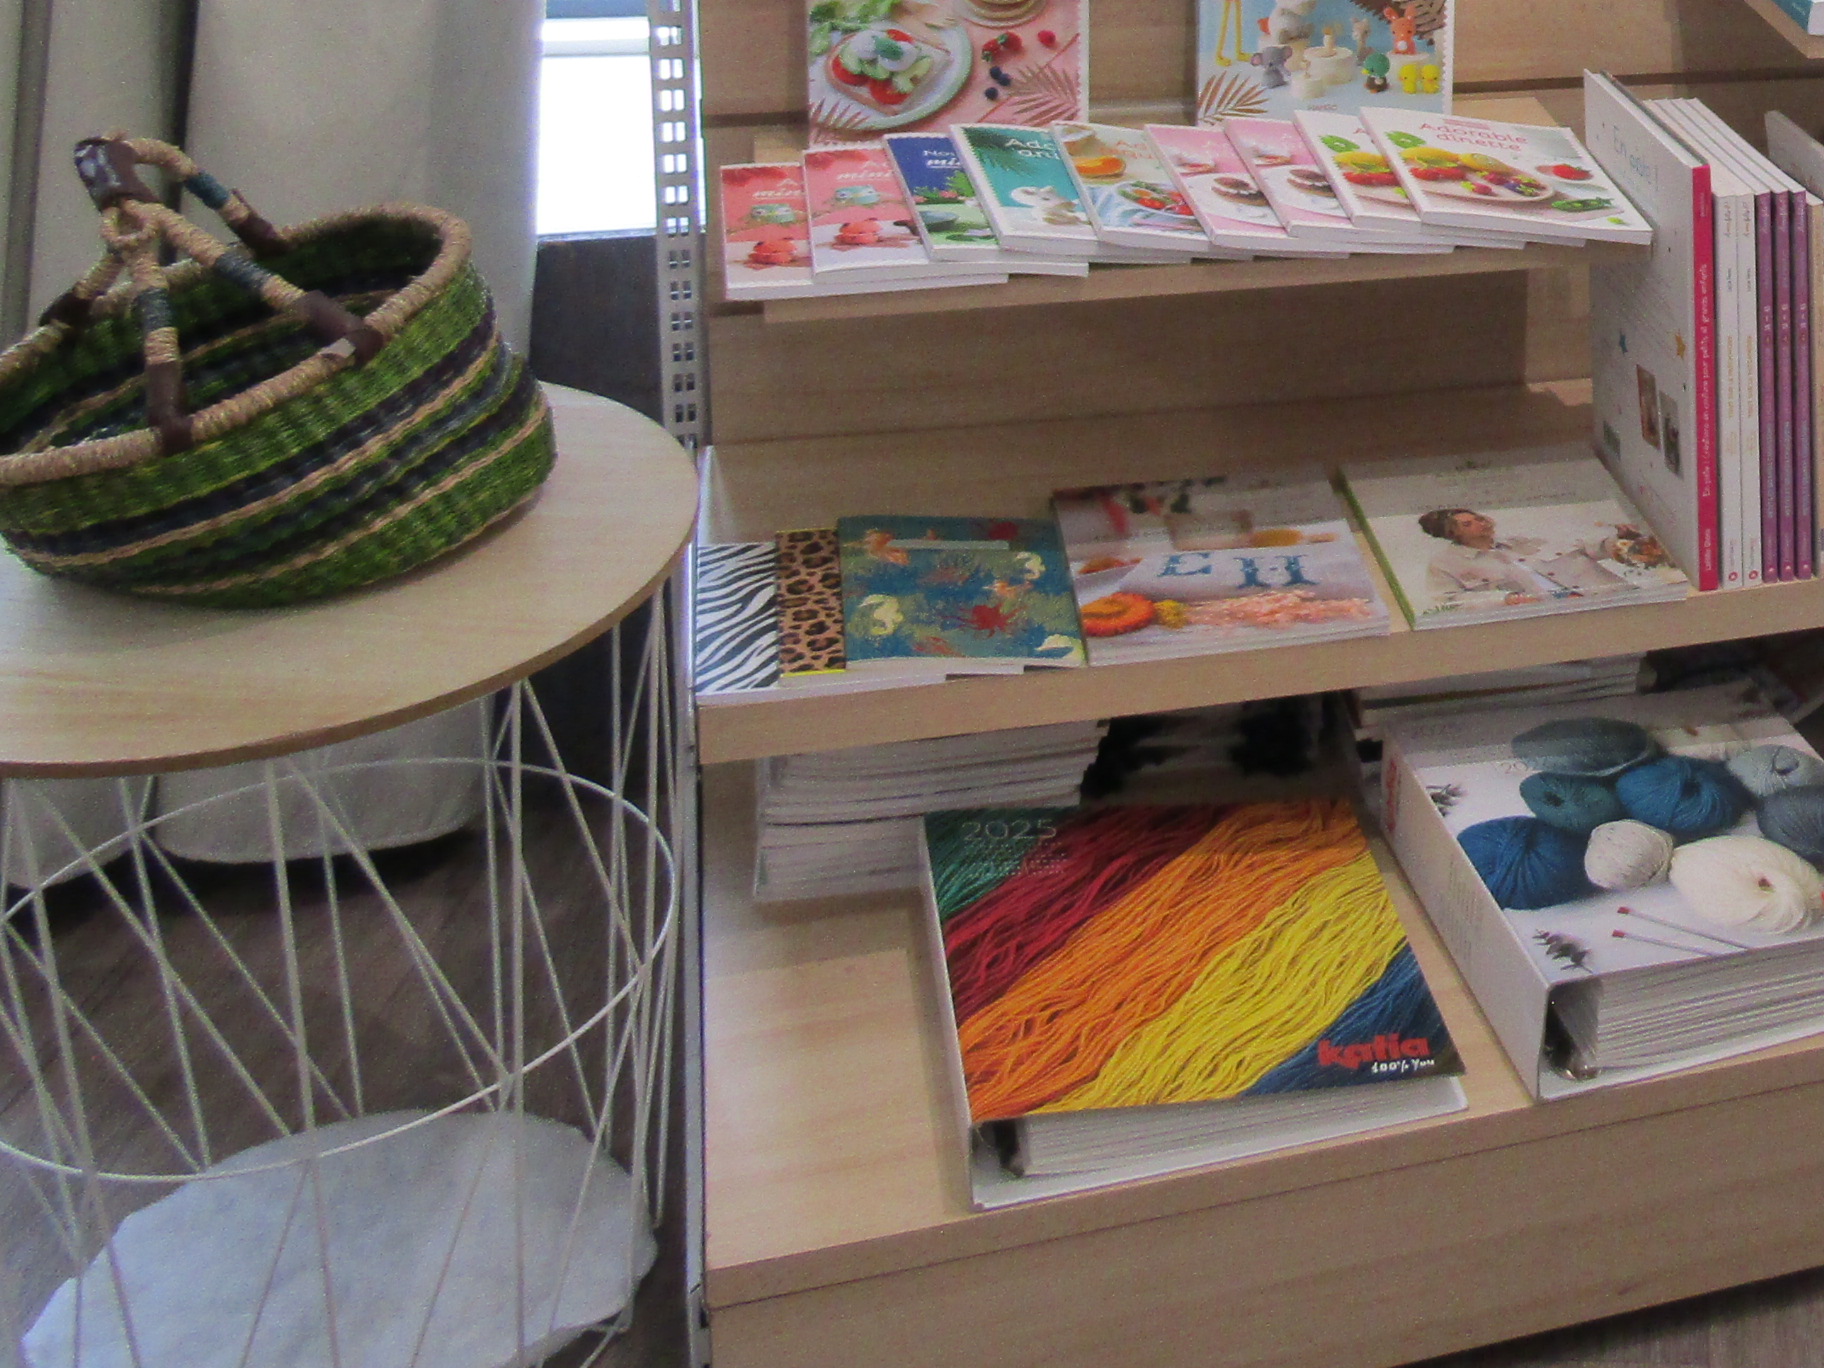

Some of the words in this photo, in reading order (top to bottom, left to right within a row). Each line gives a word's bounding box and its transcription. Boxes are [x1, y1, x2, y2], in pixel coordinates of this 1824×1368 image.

[1419, 122, 1529, 144] Adorable
[961, 819, 1058, 841] 2025
[1317, 1034, 1430, 1069] katia
